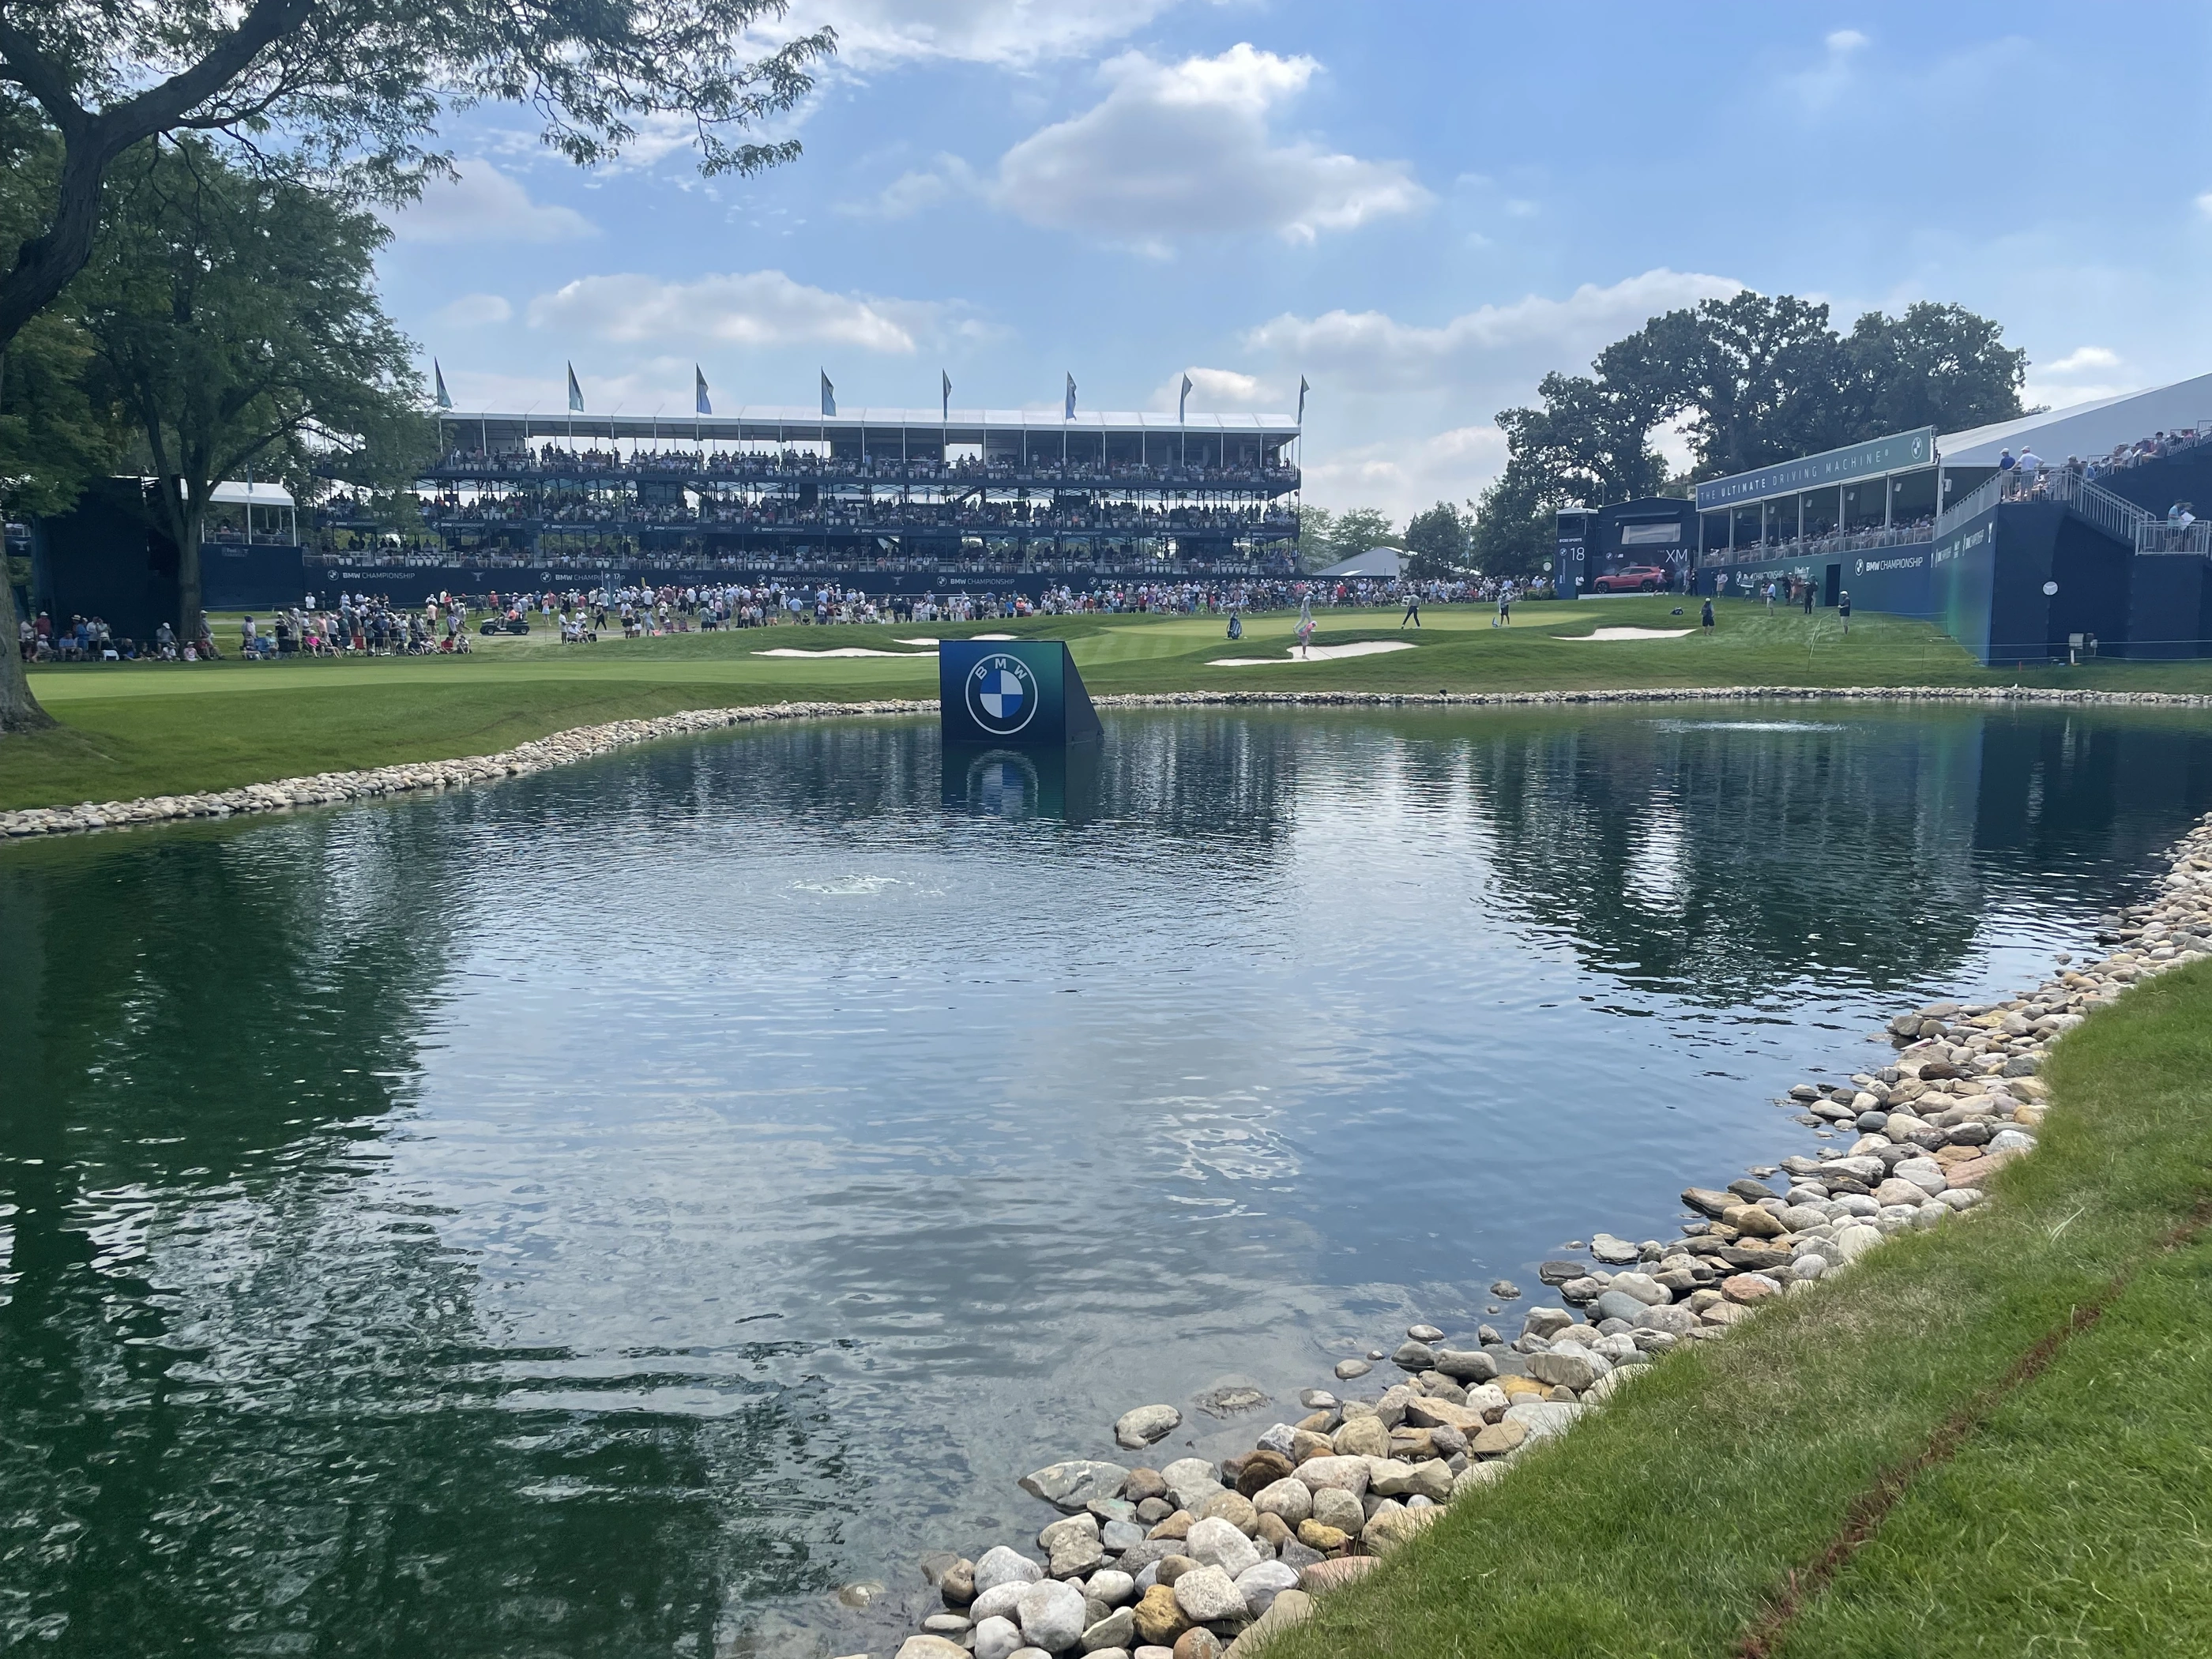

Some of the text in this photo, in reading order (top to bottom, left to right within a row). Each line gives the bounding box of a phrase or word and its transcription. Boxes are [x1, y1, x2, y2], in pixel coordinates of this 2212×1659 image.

[1700, 489, 1716, 502] THE
[1721, 478, 1766, 498] ULTIMATE
[1772, 465, 1817, 486] DRIVING
[1570, 547, 1585, 561] 18
[1665, 549, 1688, 563] XM
[1866, 557, 1923, 572] BMW CHAMPIONSHIP
[975, 658, 1027, 680] BMW
